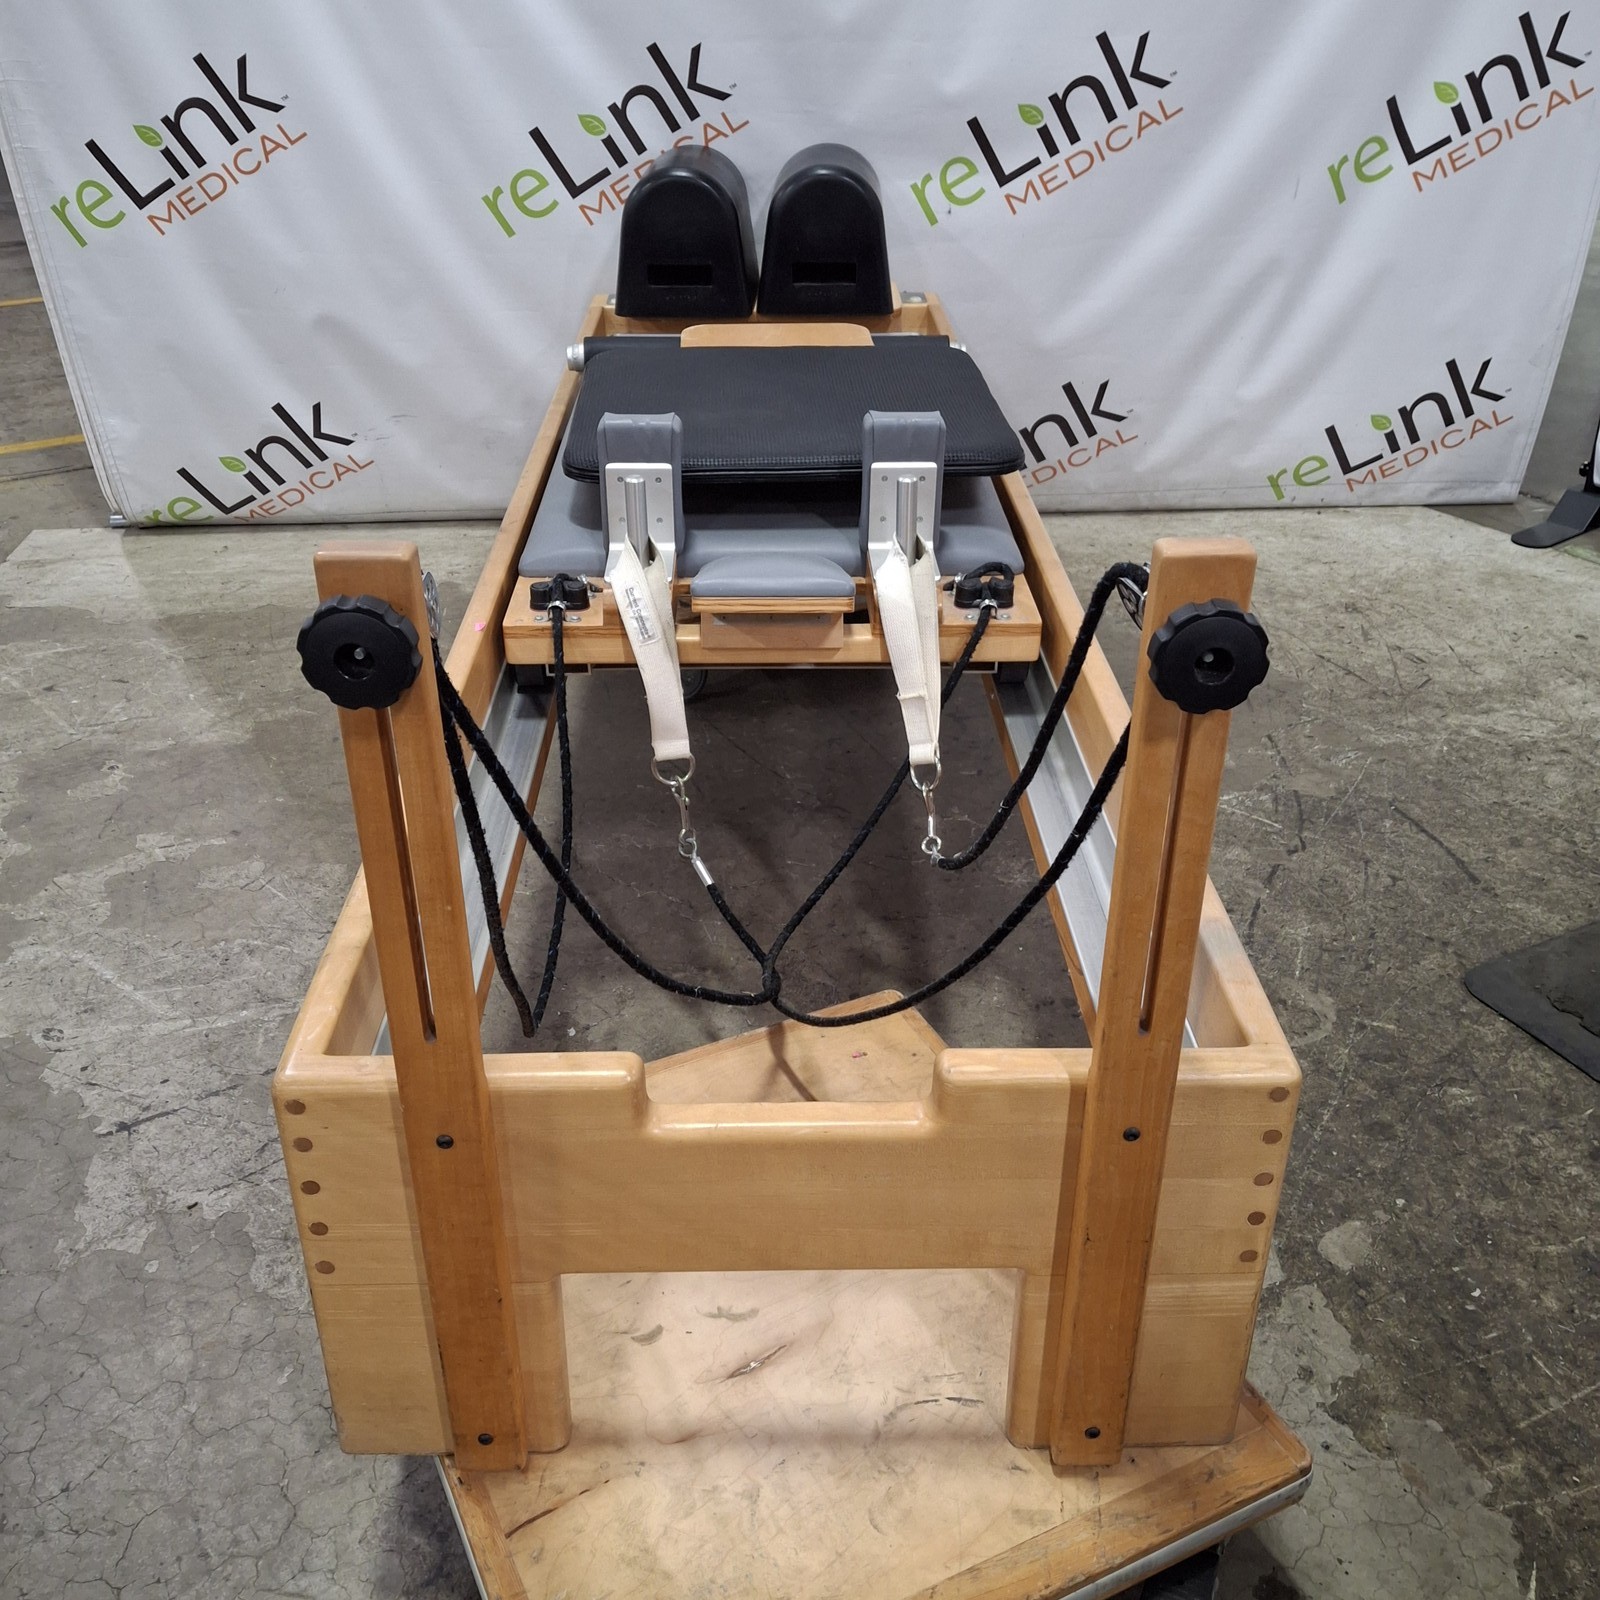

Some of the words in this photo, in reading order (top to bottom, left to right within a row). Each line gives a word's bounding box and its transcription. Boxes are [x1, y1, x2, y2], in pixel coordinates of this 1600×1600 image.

[50, 52, 285, 248] reLink
[481, 42, 732, 238] reLink
[910, 30, 1171, 226] reLink
[1004, 100, 1183, 215] MEDICAL
[1327, 11, 1586, 204] reLink
[1411, 79, 1595, 192] MEDICAL
[147, 125, 307, 236] MEDICAL
[578, 112, 749, 226] MEAL
[1022, 429, 1139, 488] DICAL
[1267, 357, 1505, 501] reLink
[1346, 409, 1513, 493] MEDICAL
[234, 454, 374, 523] MEDICAL
